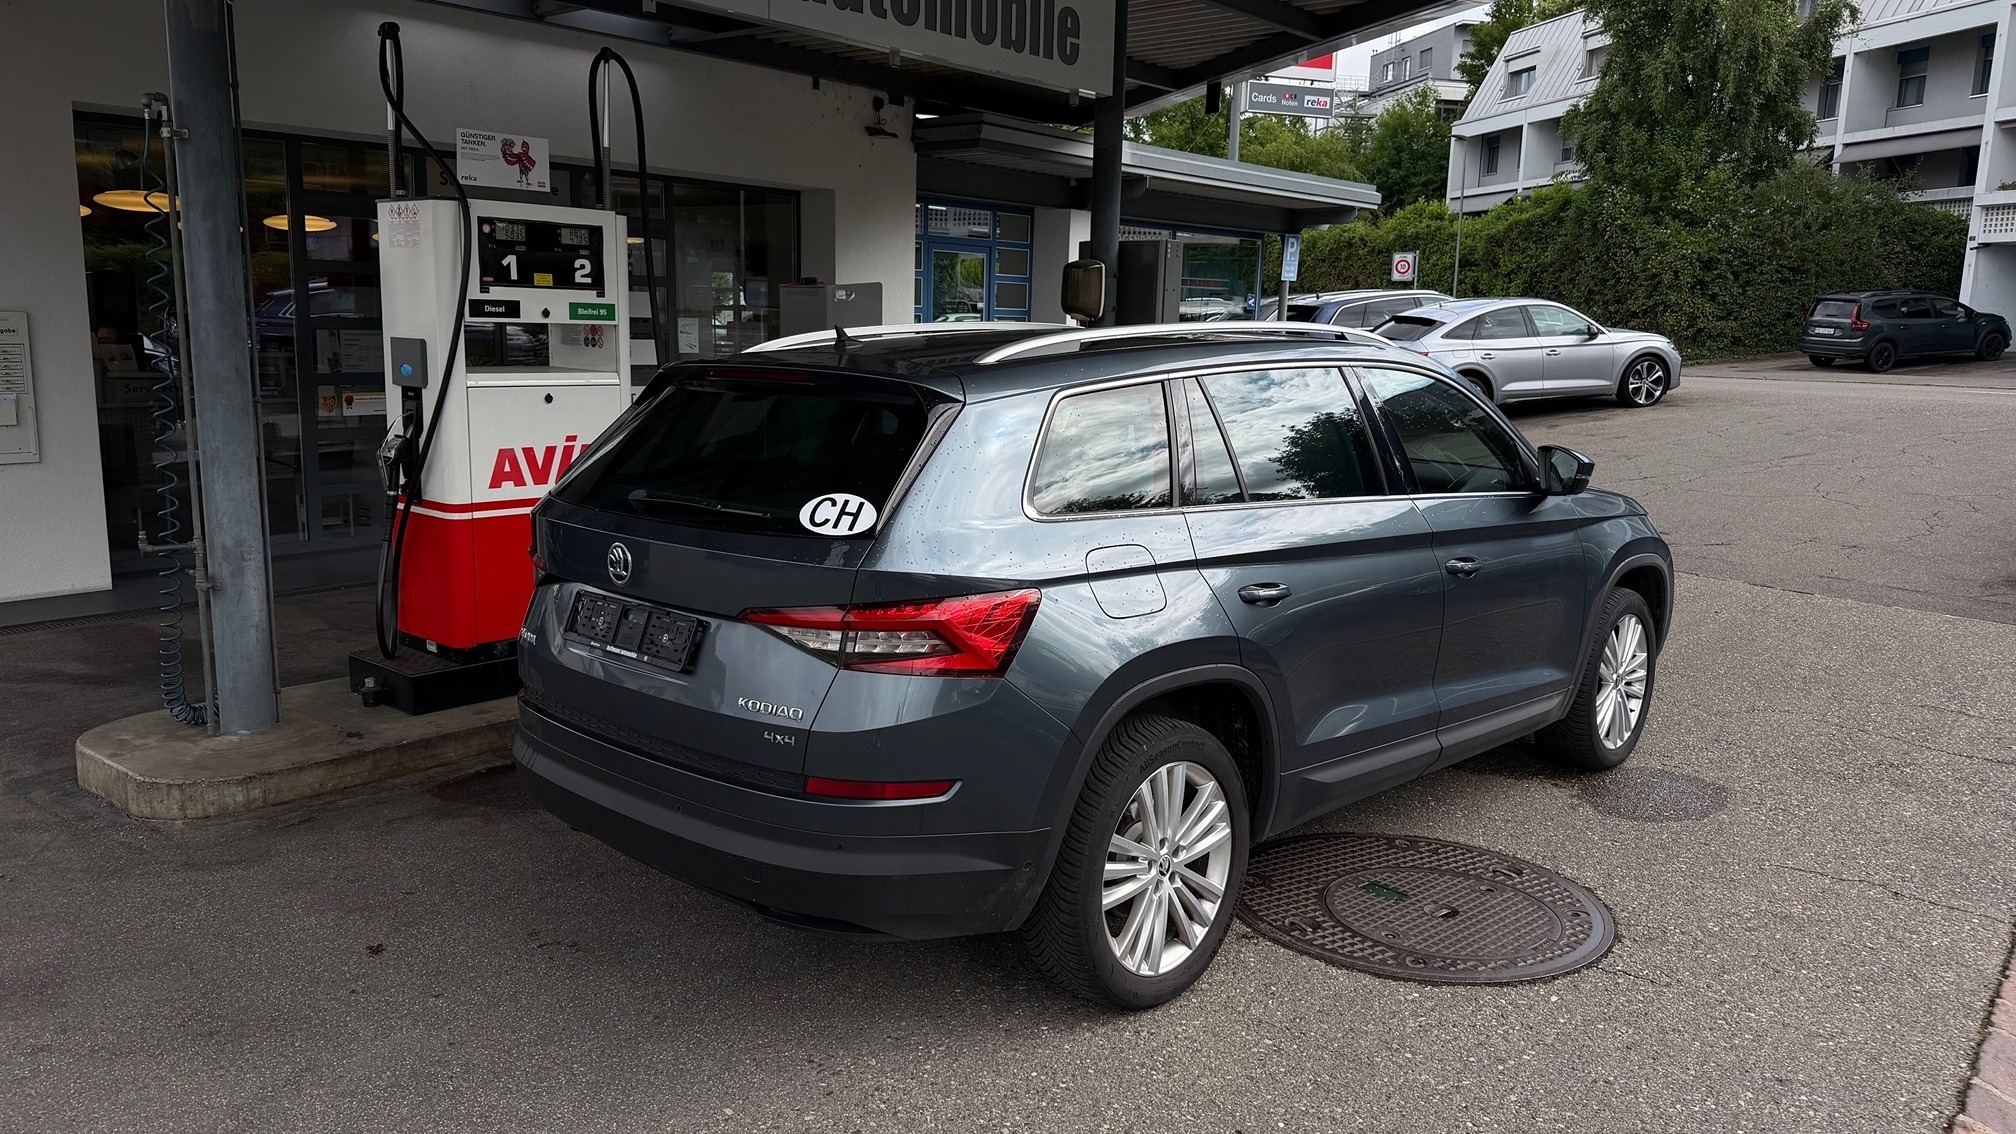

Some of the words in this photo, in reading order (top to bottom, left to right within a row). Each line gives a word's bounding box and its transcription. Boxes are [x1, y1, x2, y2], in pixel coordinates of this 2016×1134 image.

[801, 0, 1080, 66] mobile
[1251, 92, 1277, 104] Cards
[1281, 99, 1299, 107] Noten
[1305, 97, 1328, 108] reka
[460, 131, 496, 142] GÜNSTIGER
[460, 139, 487, 147] TANKEN.
[461, 174, 477, 182] reka
[1286, 237, 1297, 261] P
[501, 254, 518, 280] 1
[574, 258, 592, 283] 2
[484, 305, 505, 313] Diesel
[577, 307, 599, 315] Bleifrei
[809, 497, 865, 532] CH
[738, 697, 804, 723] KODIAQ
[763, 730, 795, 747] 4x4
[1138, 740, 1206, 775] AllSeasonContact
